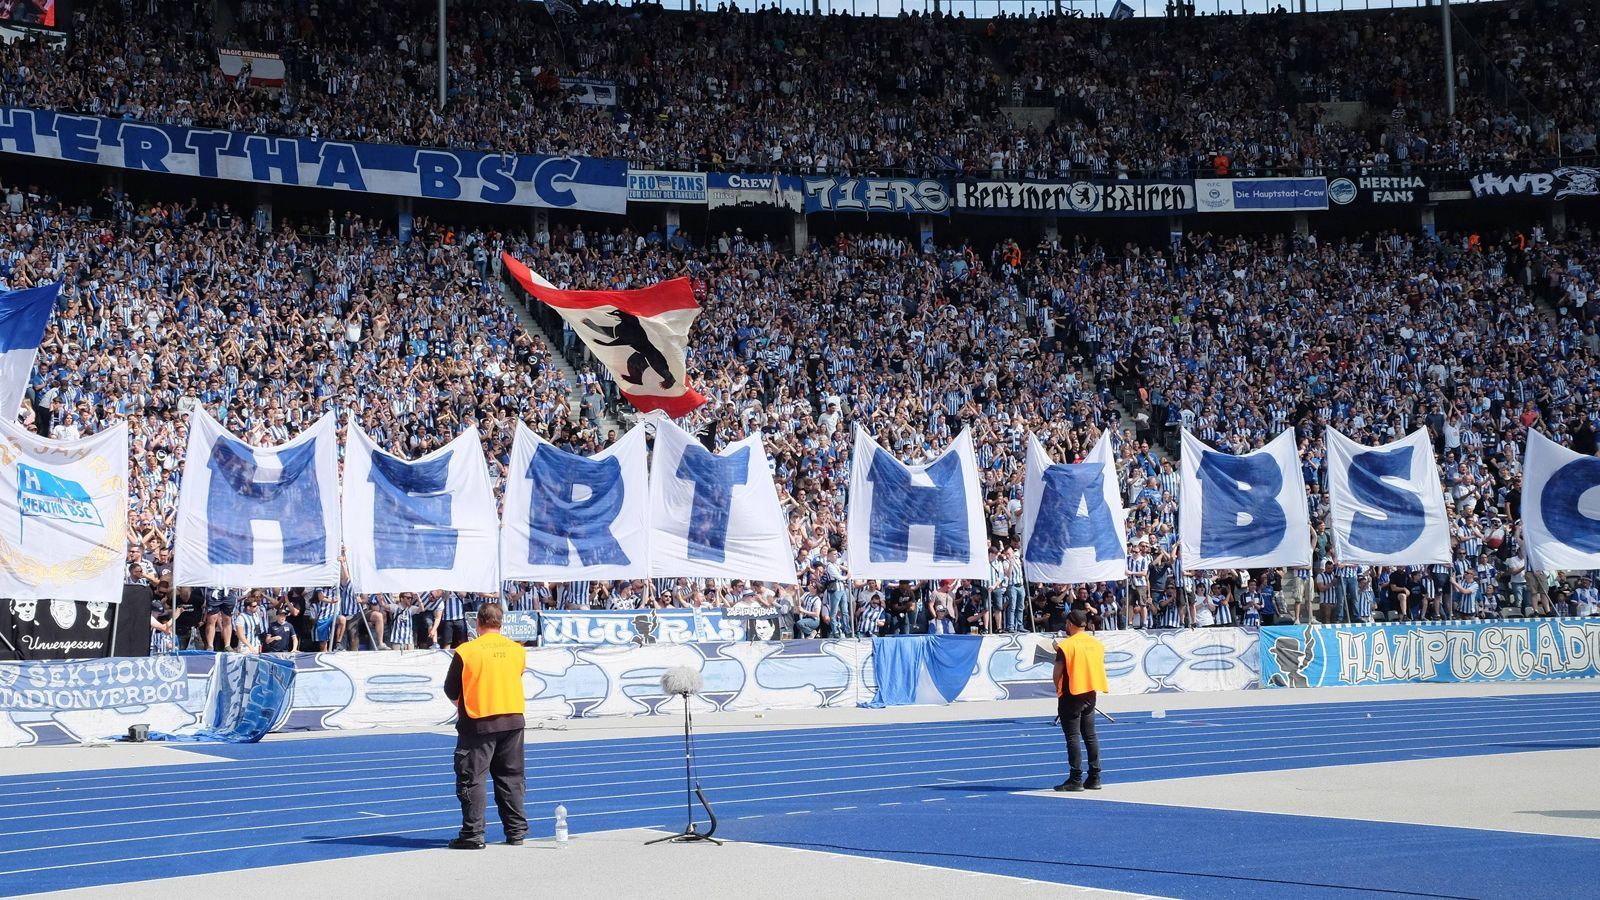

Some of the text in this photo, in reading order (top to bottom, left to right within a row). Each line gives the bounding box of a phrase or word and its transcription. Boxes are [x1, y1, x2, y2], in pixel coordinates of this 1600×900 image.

[220, 48, 241, 56] MAGIC
[0, 107, 581, 207] HERTHA BSC
[629, 175, 704, 191] PRO FANS
[1359, 176, 1425, 189] HERTHA
[629, 190, 641, 198] ZUM
[663, 191, 674, 199] DER
[806, 178, 949, 212] 71ERS
[1236, 189, 1325, 199] Die Hauptstadt-Crew
[1373, 190, 1414, 203] FANS
[22, 497, 93, 519] HERTHA BSC
[22, 634, 104, 654] Unvergessen
[28, 657, 158, 688] SEKTION
